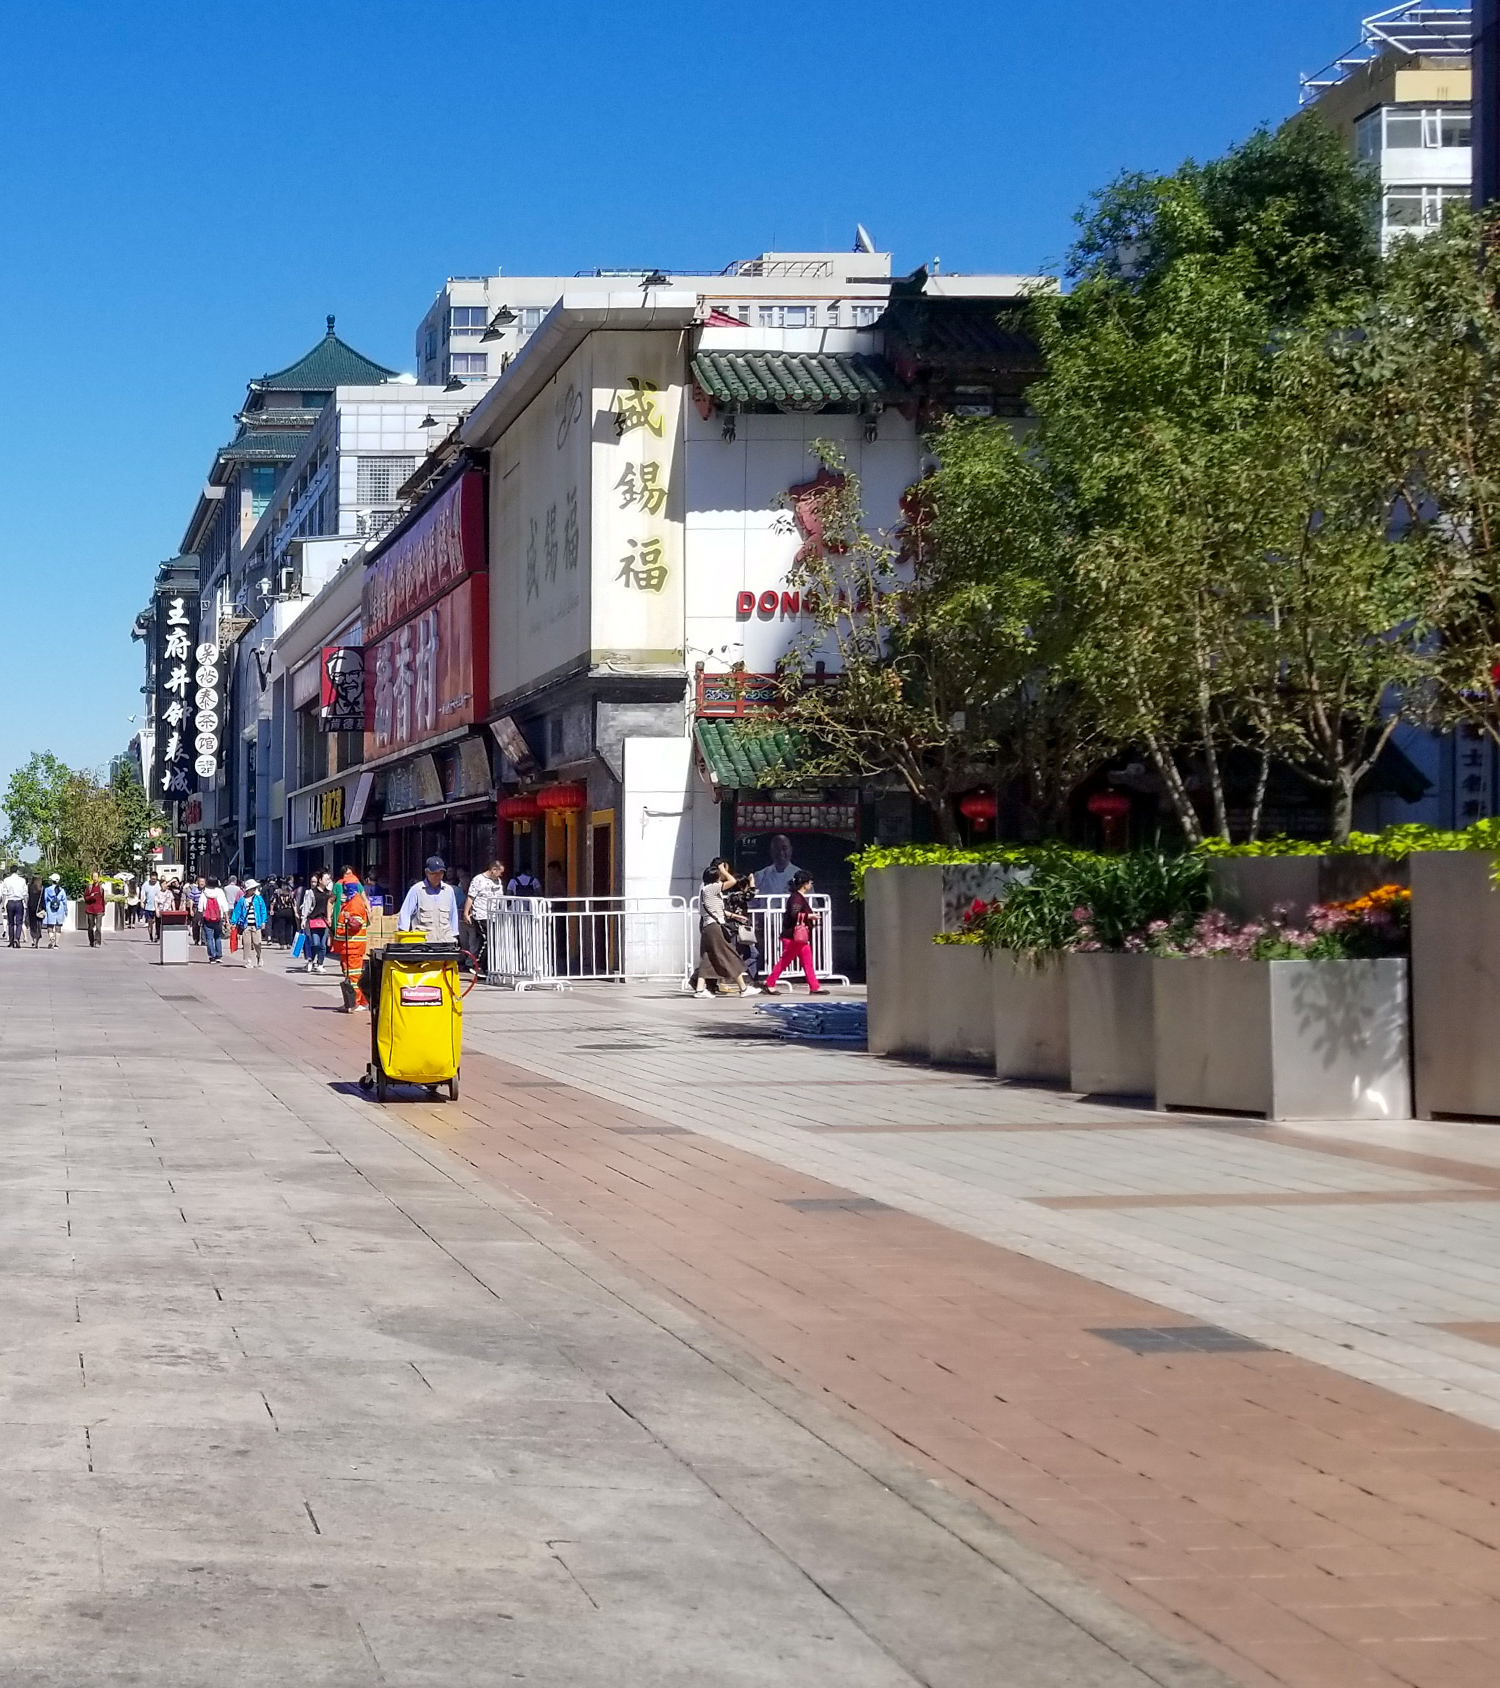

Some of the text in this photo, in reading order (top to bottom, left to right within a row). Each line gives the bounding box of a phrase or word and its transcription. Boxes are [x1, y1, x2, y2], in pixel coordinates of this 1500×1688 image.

[161, 597, 194, 796] 王府井钟表城
[197, 644, 217, 750] 吴裕泰茶馆
[307, 794, 321, 834] HLA
